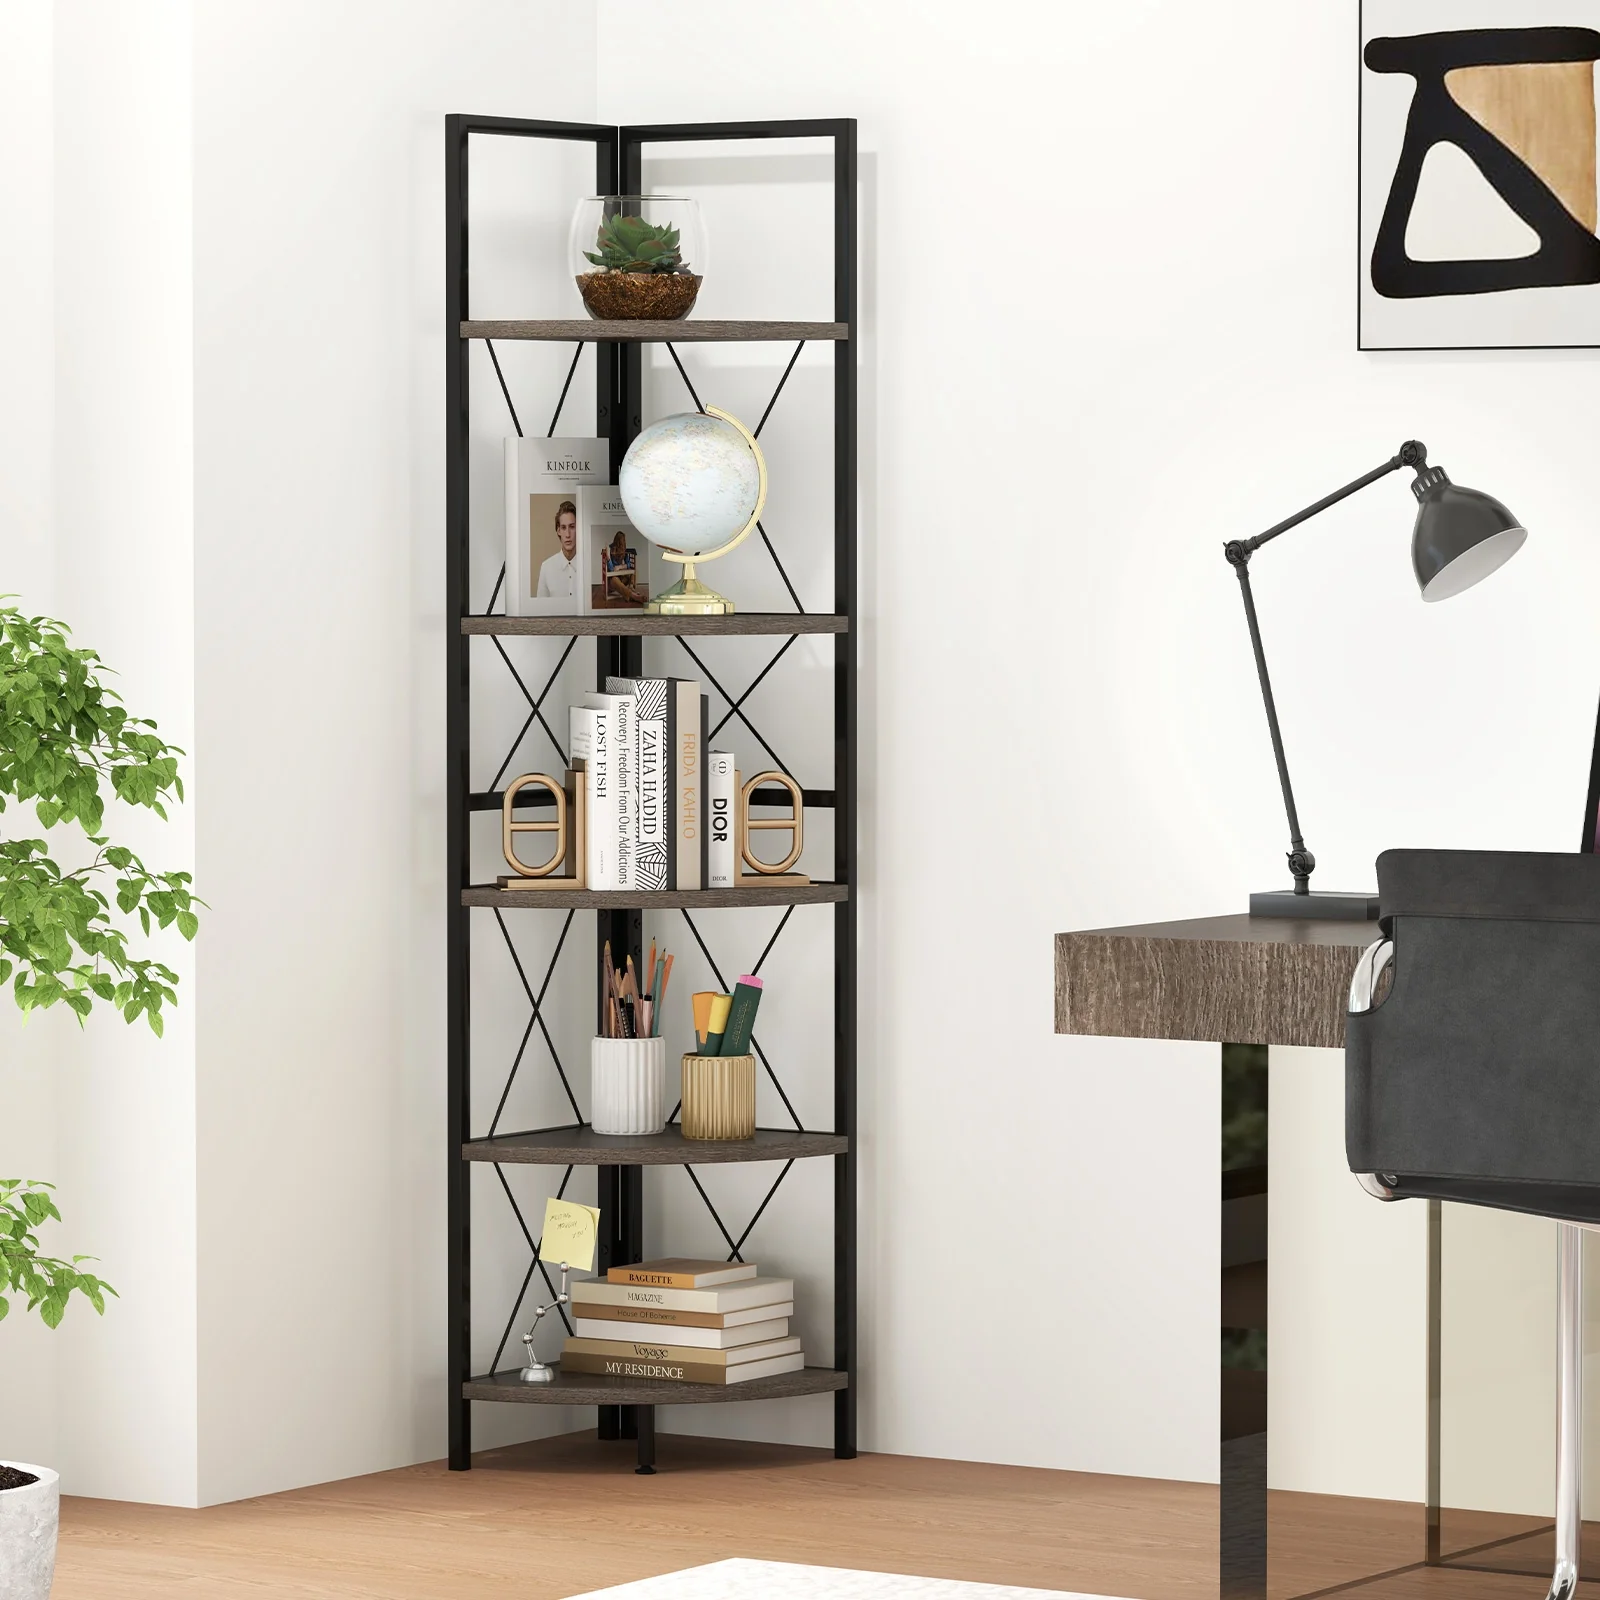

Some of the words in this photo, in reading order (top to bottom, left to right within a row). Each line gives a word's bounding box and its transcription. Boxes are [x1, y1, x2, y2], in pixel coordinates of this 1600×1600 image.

[546, 461, 591, 471] KINFOLK
[602, 502, 624, 510] KINFO
[596, 714, 607, 757] LOST
[618, 748, 631, 788] Freedom
[642, 730, 657, 776] ZAHA
[683, 733, 696, 777] FRIDA
[596, 761, 607, 798] FISH
[618, 790, 630, 814] From
[642, 780, 657, 835] HADID
[683, 787, 696, 840] KAHLO
[618, 816, 631, 834] Our
[712, 798, 728, 843] DIOR
[618, 836, 632, 885] Addictions
[629, 1273, 673, 1285] BAGUETTE
[627, 1292, 664, 1305] MAGAZINE
[617, 1309, 638, 1318] House
[649, 1312, 677, 1321] Boheme
[633, 1344, 669, 1359] Voyage
[605, 1361, 623, 1374] MY
[624, 1363, 684, 1379] RESIDENCE
